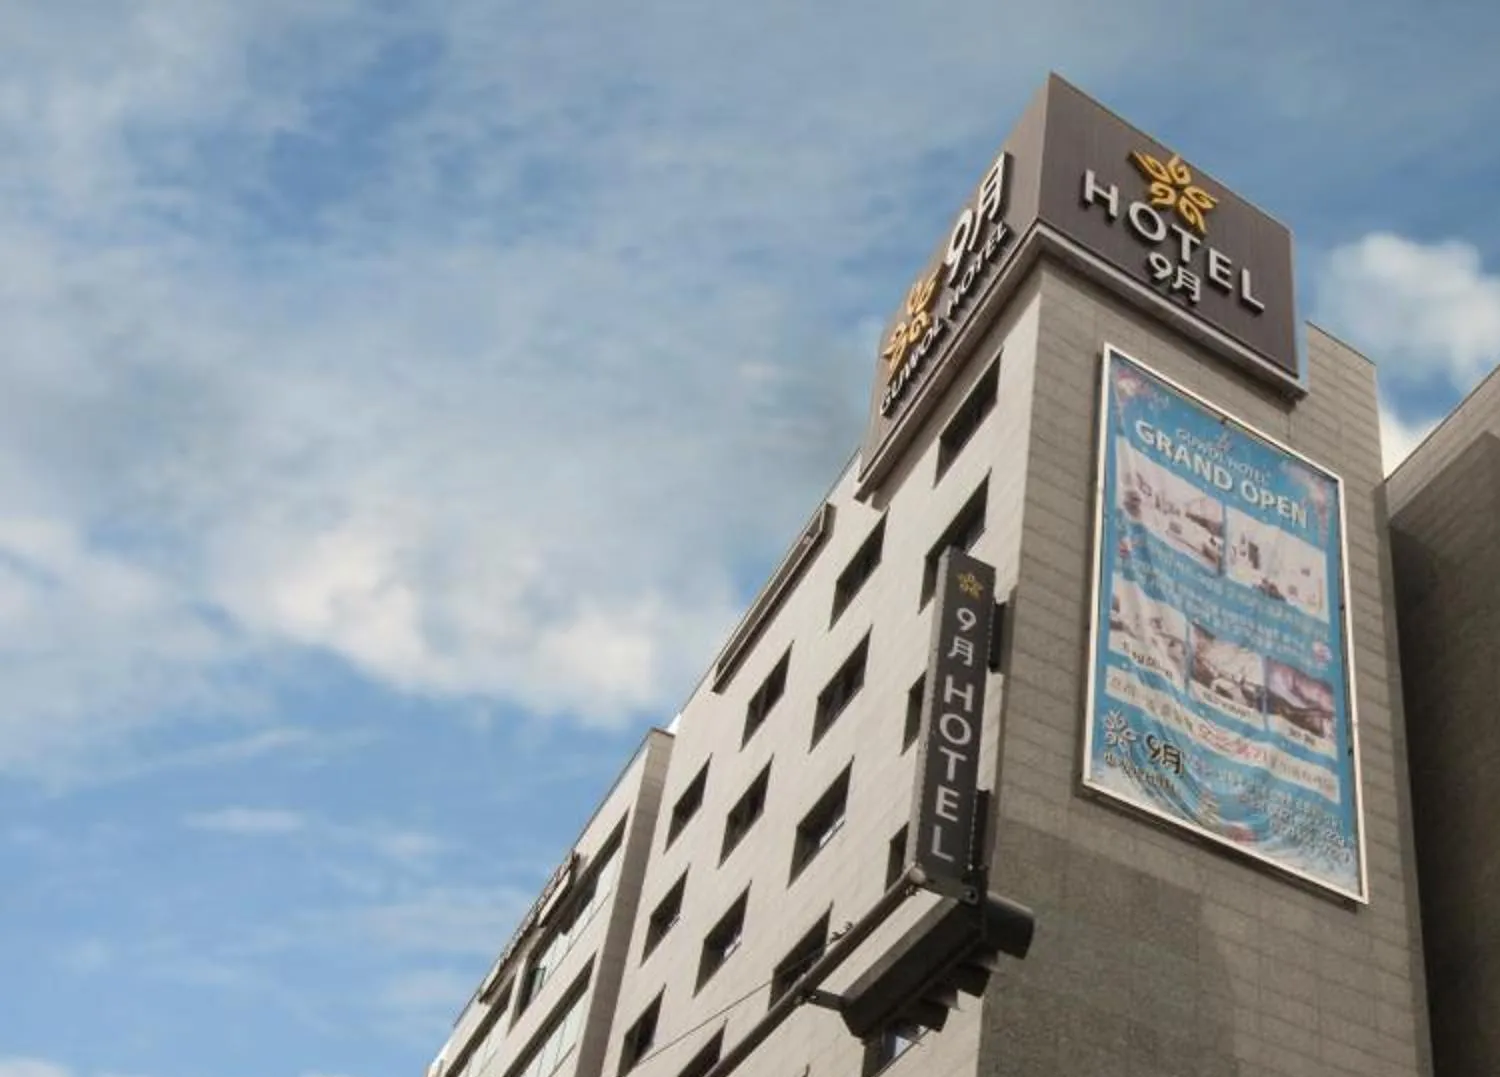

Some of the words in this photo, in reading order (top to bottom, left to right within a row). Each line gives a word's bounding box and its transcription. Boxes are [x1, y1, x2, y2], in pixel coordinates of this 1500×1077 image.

[1083, 168, 1265, 312] HOTEL
[1148, 252, 1202, 305] 9月
[1135, 419, 1233, 491] GRAND
[1240, 479, 1307, 529] OPEN
[948, 607, 977, 667] 9月
[931, 675, 974, 862] HOTEL
